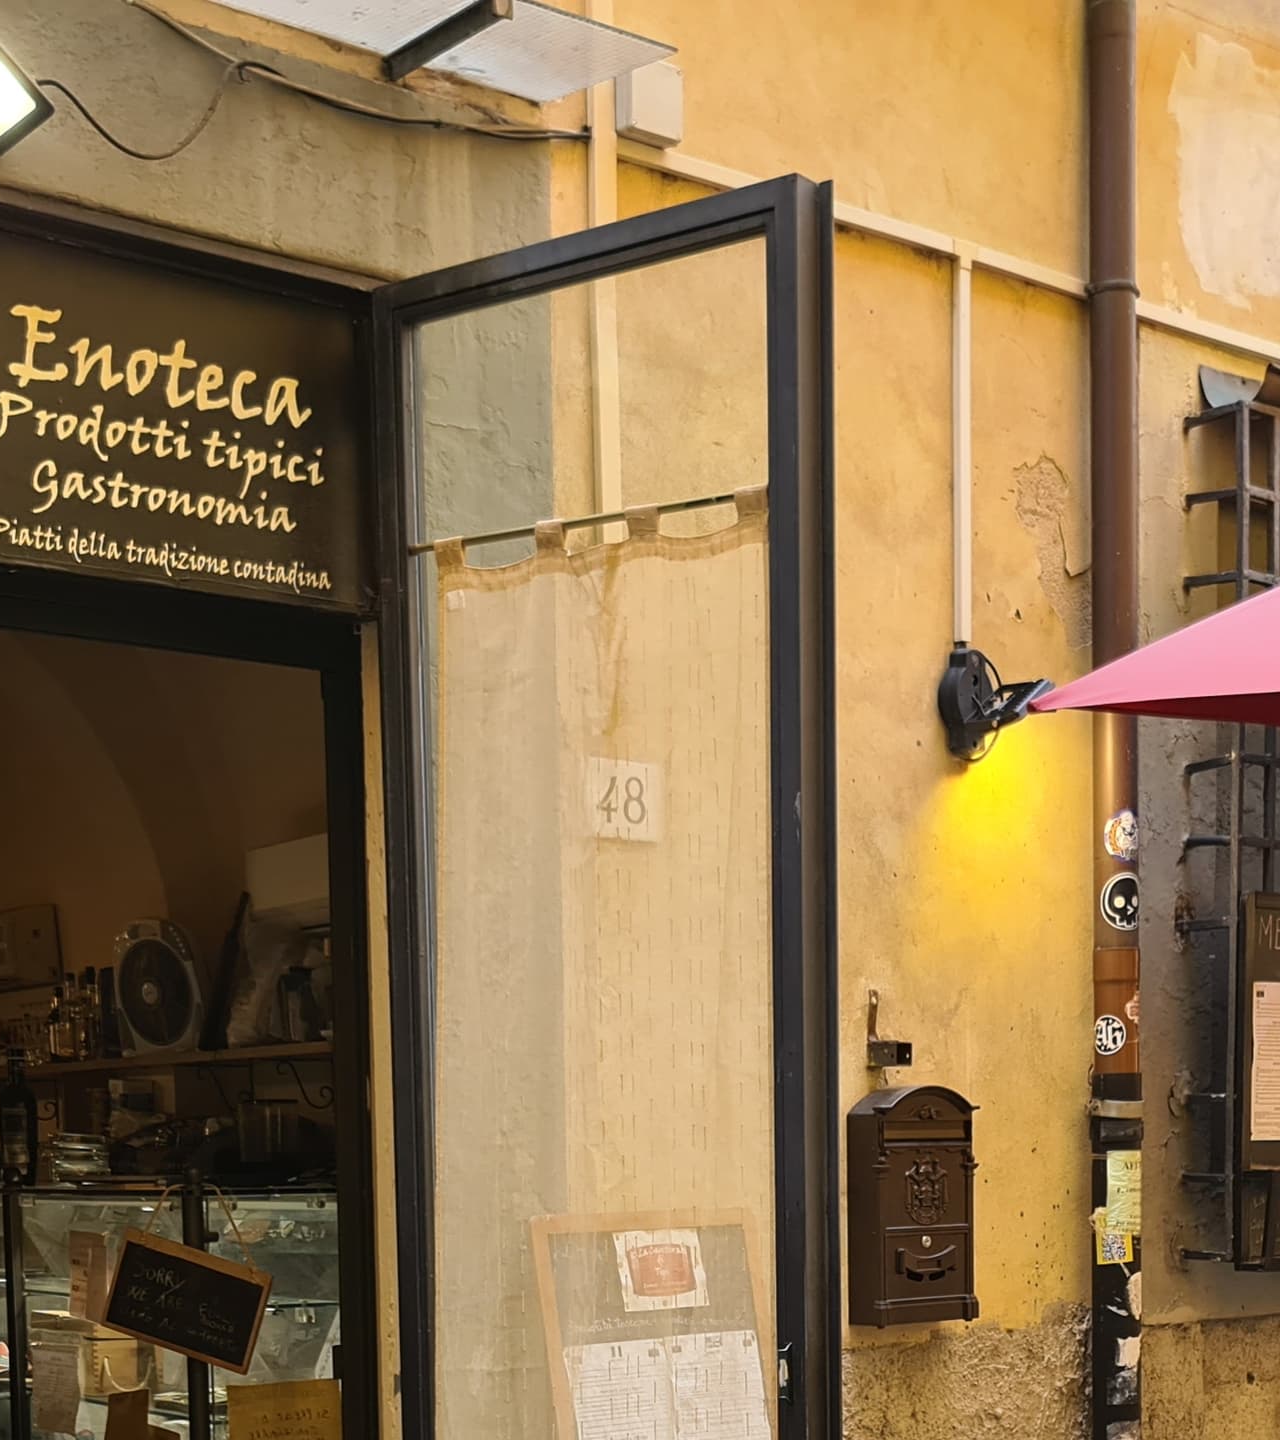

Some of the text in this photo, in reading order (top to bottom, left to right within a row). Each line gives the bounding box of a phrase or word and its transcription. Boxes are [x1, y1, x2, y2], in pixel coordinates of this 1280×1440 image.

[8, 304, 313, 428] Enoteca
[31, 460, 297, 533] Gastronomia
[202, 431, 325, 499] tipici
[68, 529, 122, 563] della
[126, 539, 230, 577] tradizione
[234, 558, 332, 594] contadina
[596, 776, 646, 824] 48
